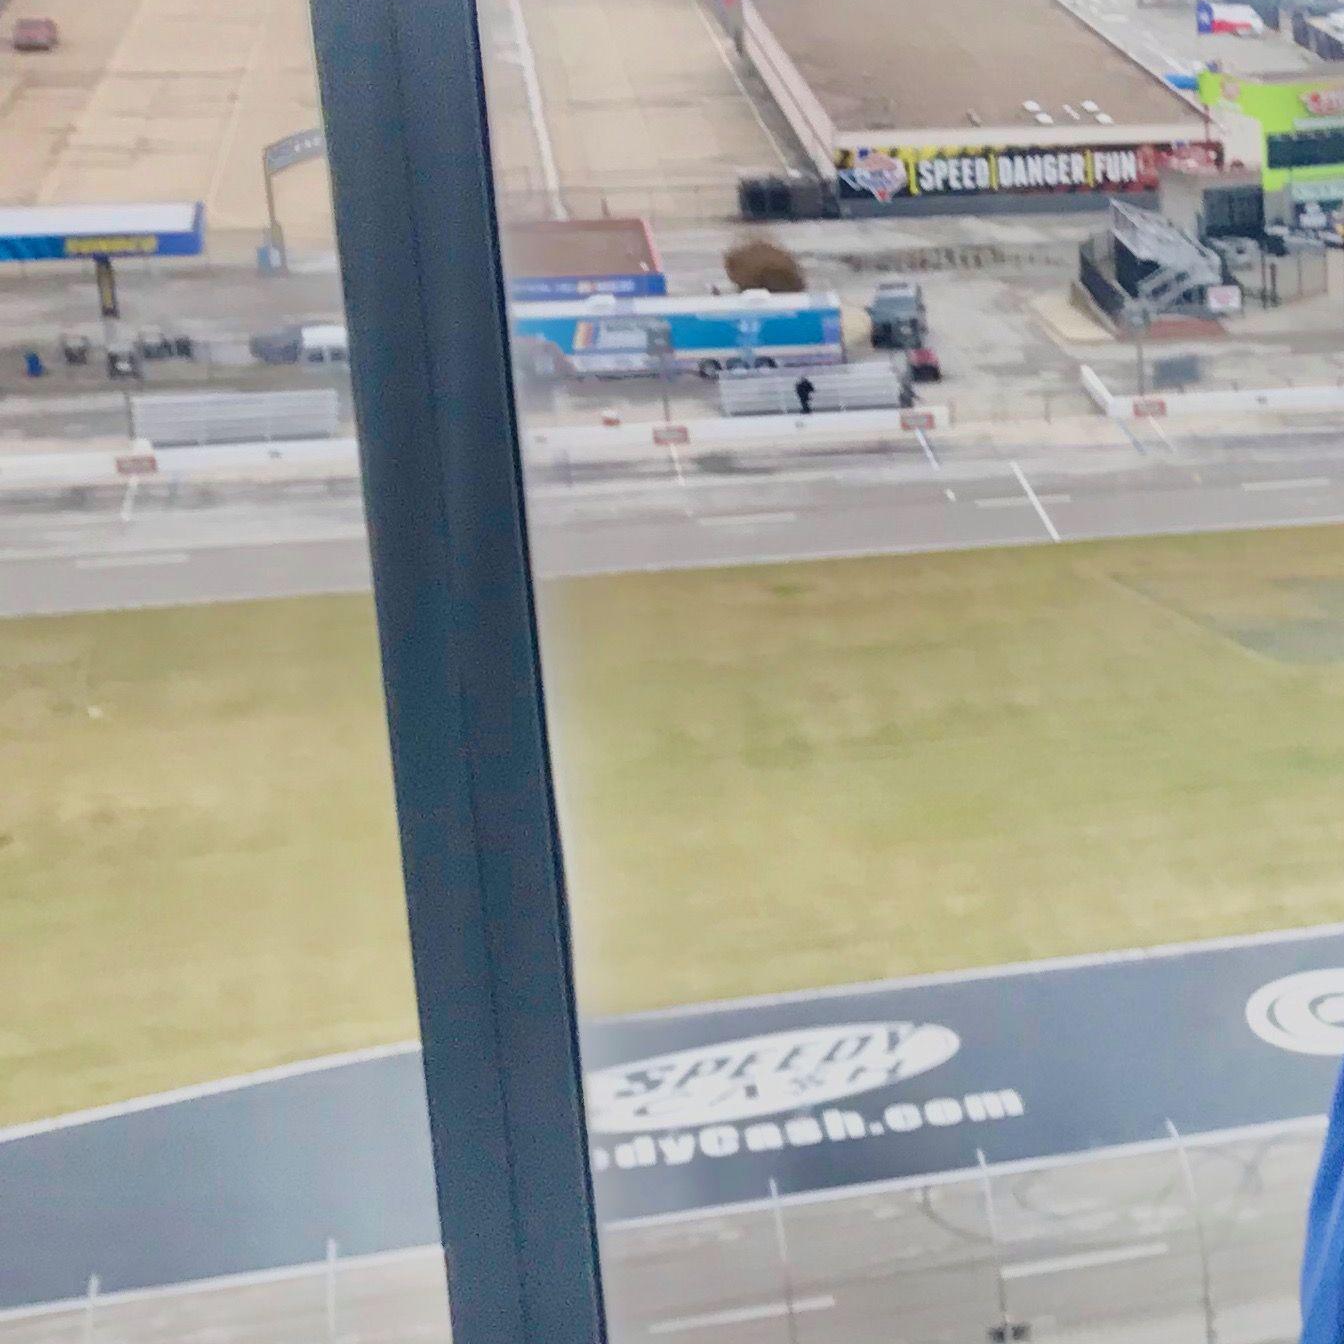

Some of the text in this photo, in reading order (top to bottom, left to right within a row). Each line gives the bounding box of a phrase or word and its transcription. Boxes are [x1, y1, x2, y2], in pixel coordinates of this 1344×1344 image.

[918, 155, 990, 192] SPEED
[1002, 153, 1085, 189] DANGER
[1095, 149, 1138, 182] FUN
[613, 1026, 912, 1099] SPEEDY
